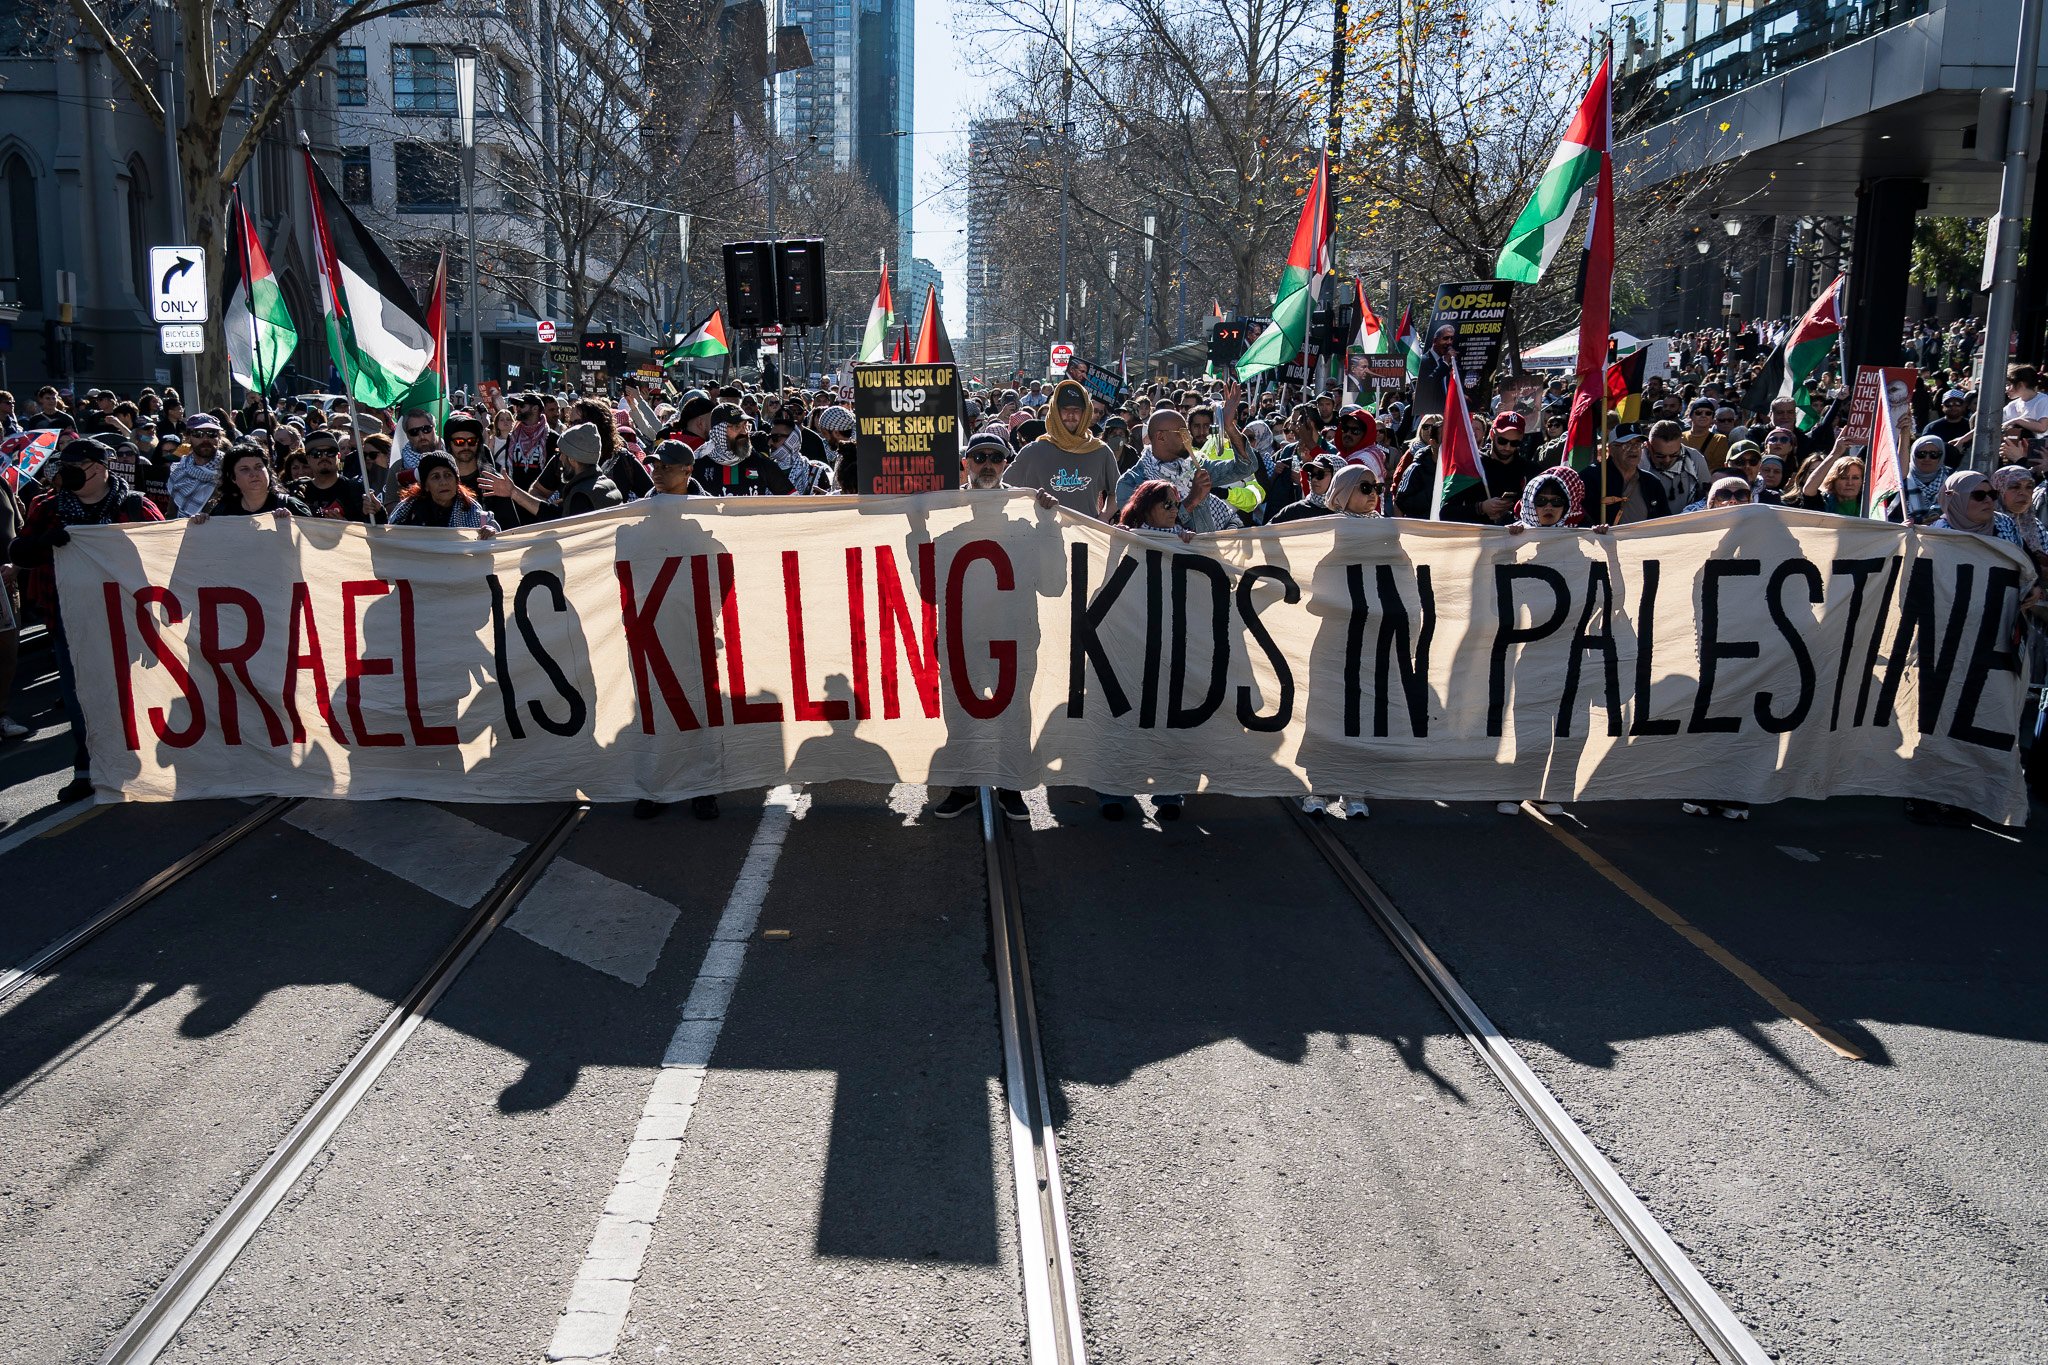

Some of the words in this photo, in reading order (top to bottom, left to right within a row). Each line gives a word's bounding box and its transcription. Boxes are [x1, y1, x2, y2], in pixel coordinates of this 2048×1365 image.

[161, 301, 198, 312] ONLY
[1440, 311, 1458, 320] DID
[1460, 310, 1471, 319] IT
[1471, 309, 1505, 319] AGAIN
[1460, 323, 1475, 334] BIBI
[1475, 322, 1502, 334] SPEARS
[1395, 359, 1404, 367] NO
[857, 370, 901, 388] YOU'RE
[904, 369, 934, 386] SICK
[936, 368, 952, 385] OF
[1371, 378, 1379, 387] IN
[1381, 377, 1400, 388] GAZA
[1859, 372, 1879, 384] END
[1857, 386, 1876, 399] THE
[890, 389, 926, 413] US?
[1853, 399, 1875, 413] SIEG
[861, 417, 901, 435] WE'RE
[905, 416, 935, 434] SICK
[938, 415, 954, 433] OF
[1850, 413, 1865, 425] ON
[882, 434, 934, 452] 'ISRAEL'
[109, 461, 136, 473] DEATH
[881, 456, 935, 475] KILLING
[872, 475, 945, 494] CHILDREN!
[103, 580, 460, 752] ISRAEL
[486, 570, 586, 738] IS
[616, 539, 1017, 735] KILLING
[1067, 542, 1300, 731] KIDS
[1344, 564, 1436, 737] IN
[1486, 555, 2022, 751] PALESTINE
